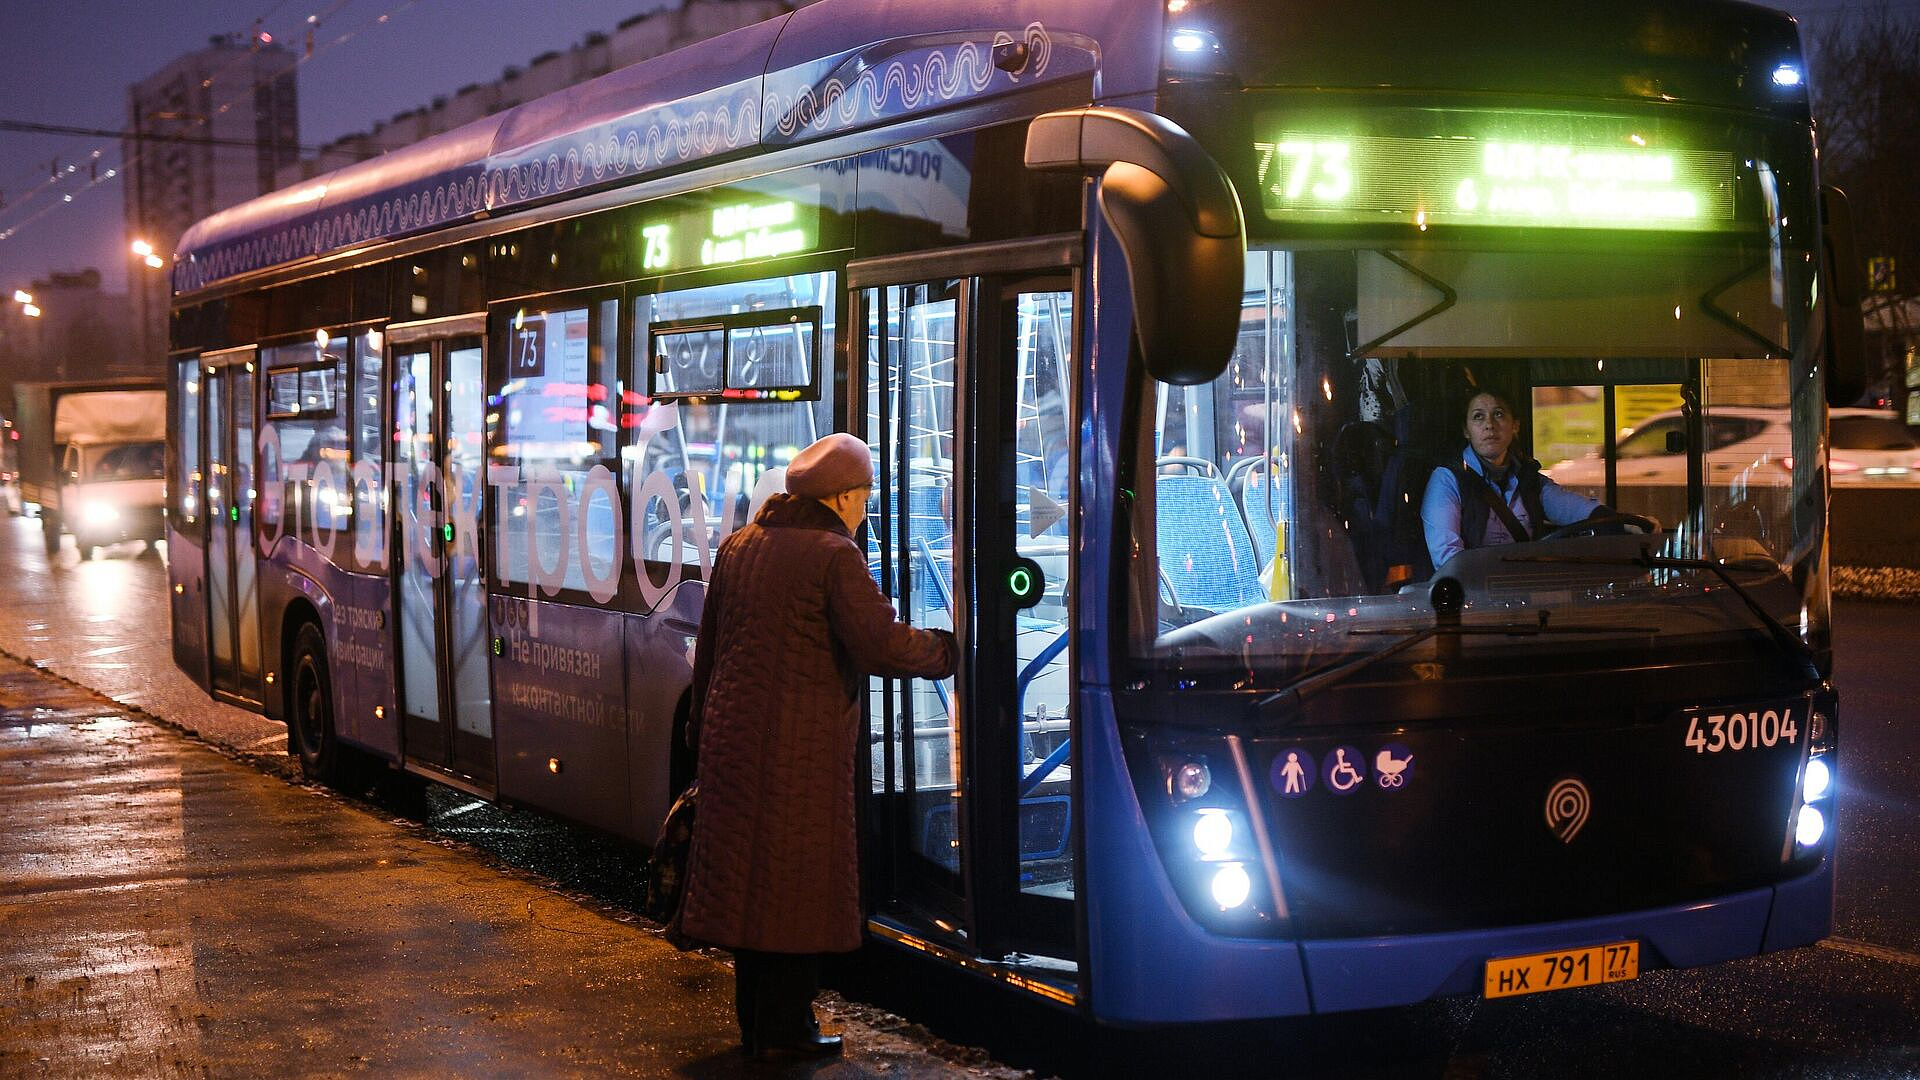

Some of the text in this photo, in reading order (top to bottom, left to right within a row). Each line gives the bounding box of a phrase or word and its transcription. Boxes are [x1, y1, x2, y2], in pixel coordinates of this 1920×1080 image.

[1276, 141, 1351, 200] 73
[643, 224, 670, 268] 73
[519, 328, 537, 368] 73
[258, 423, 337, 565] Это
[511, 629, 601, 679] Не привязан
[522, 683, 605, 728] контактной
[1685, 708, 1798, 753] 430104
[1543, 952, 1591, 987] 791
[1606, 945, 1631, 971] 77
[1609, 969, 1627, 979] RUS
